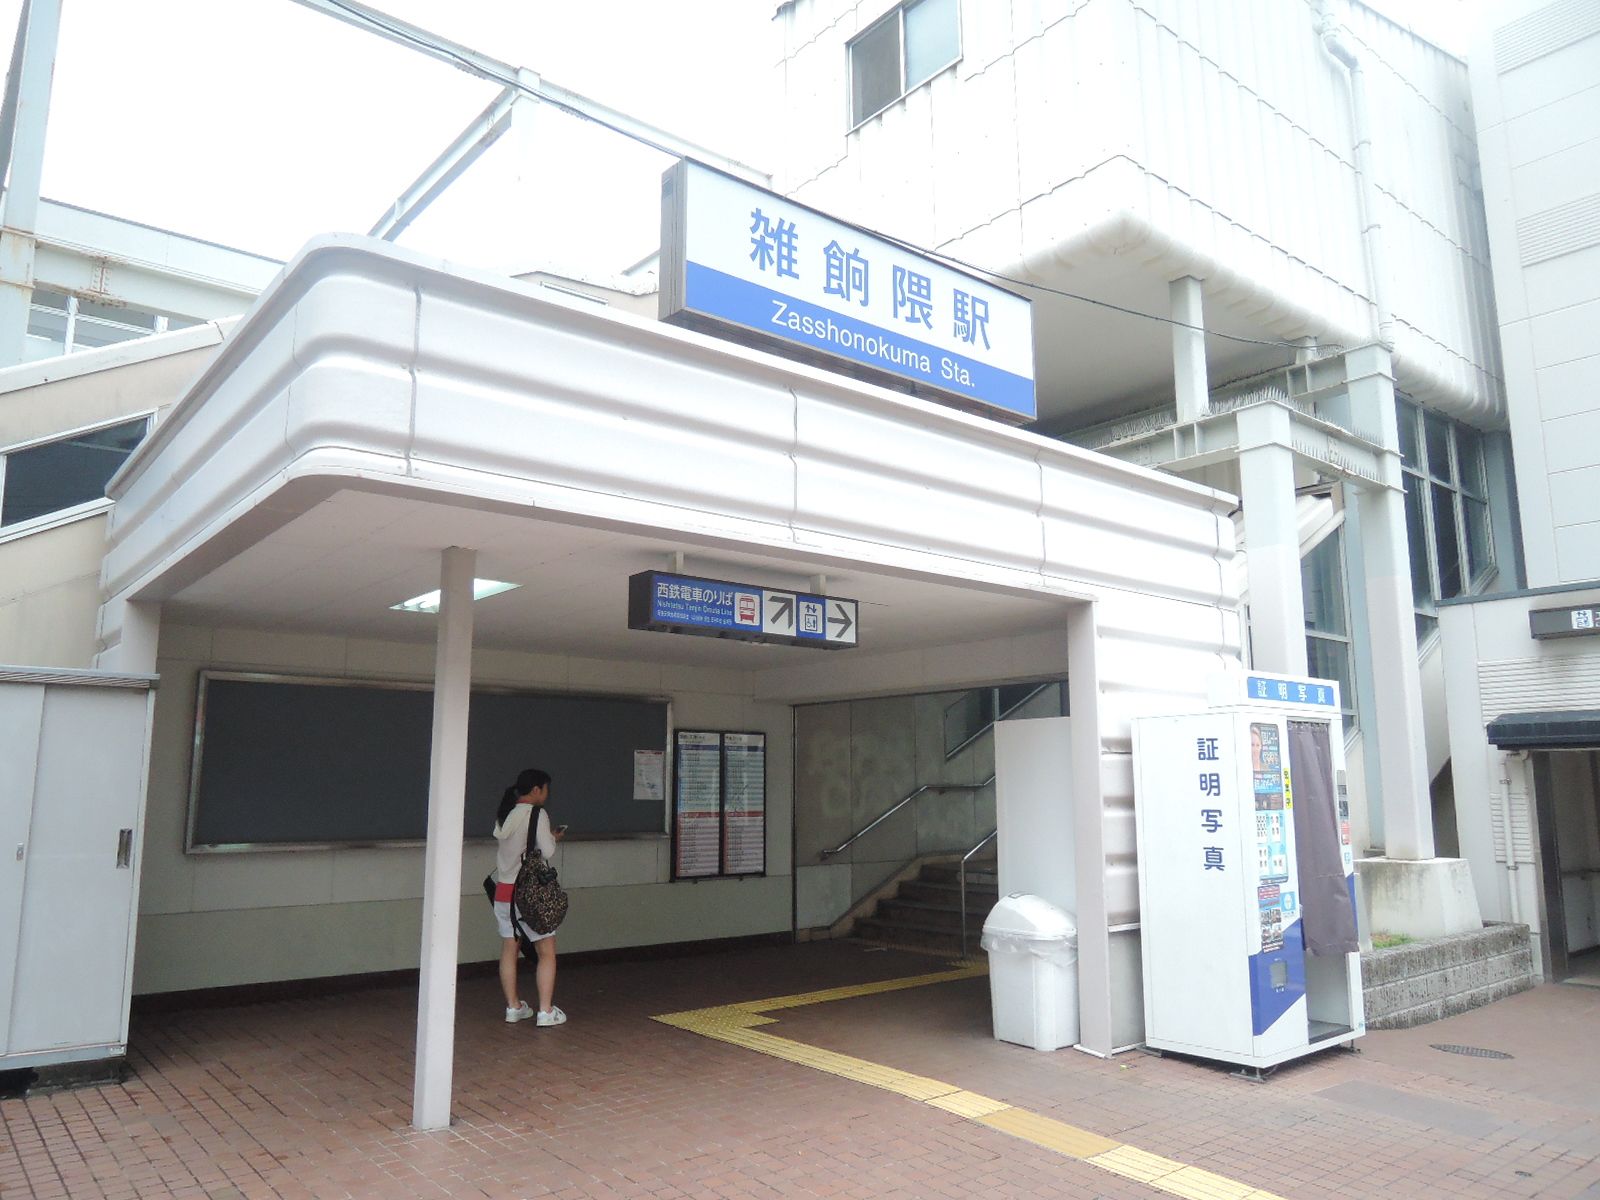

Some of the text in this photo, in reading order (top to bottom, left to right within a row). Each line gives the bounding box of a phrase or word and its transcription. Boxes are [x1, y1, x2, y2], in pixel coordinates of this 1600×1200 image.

[750, 207, 992, 350] 雑餉隈駅
[771, 299, 976, 388] Zasshonokuma Sta.
[656, 582, 734, 606] 西鉄電車のりば
[1257, 680, 1326, 704] 証明写真
[1197, 738, 1226, 871] 証明写真
